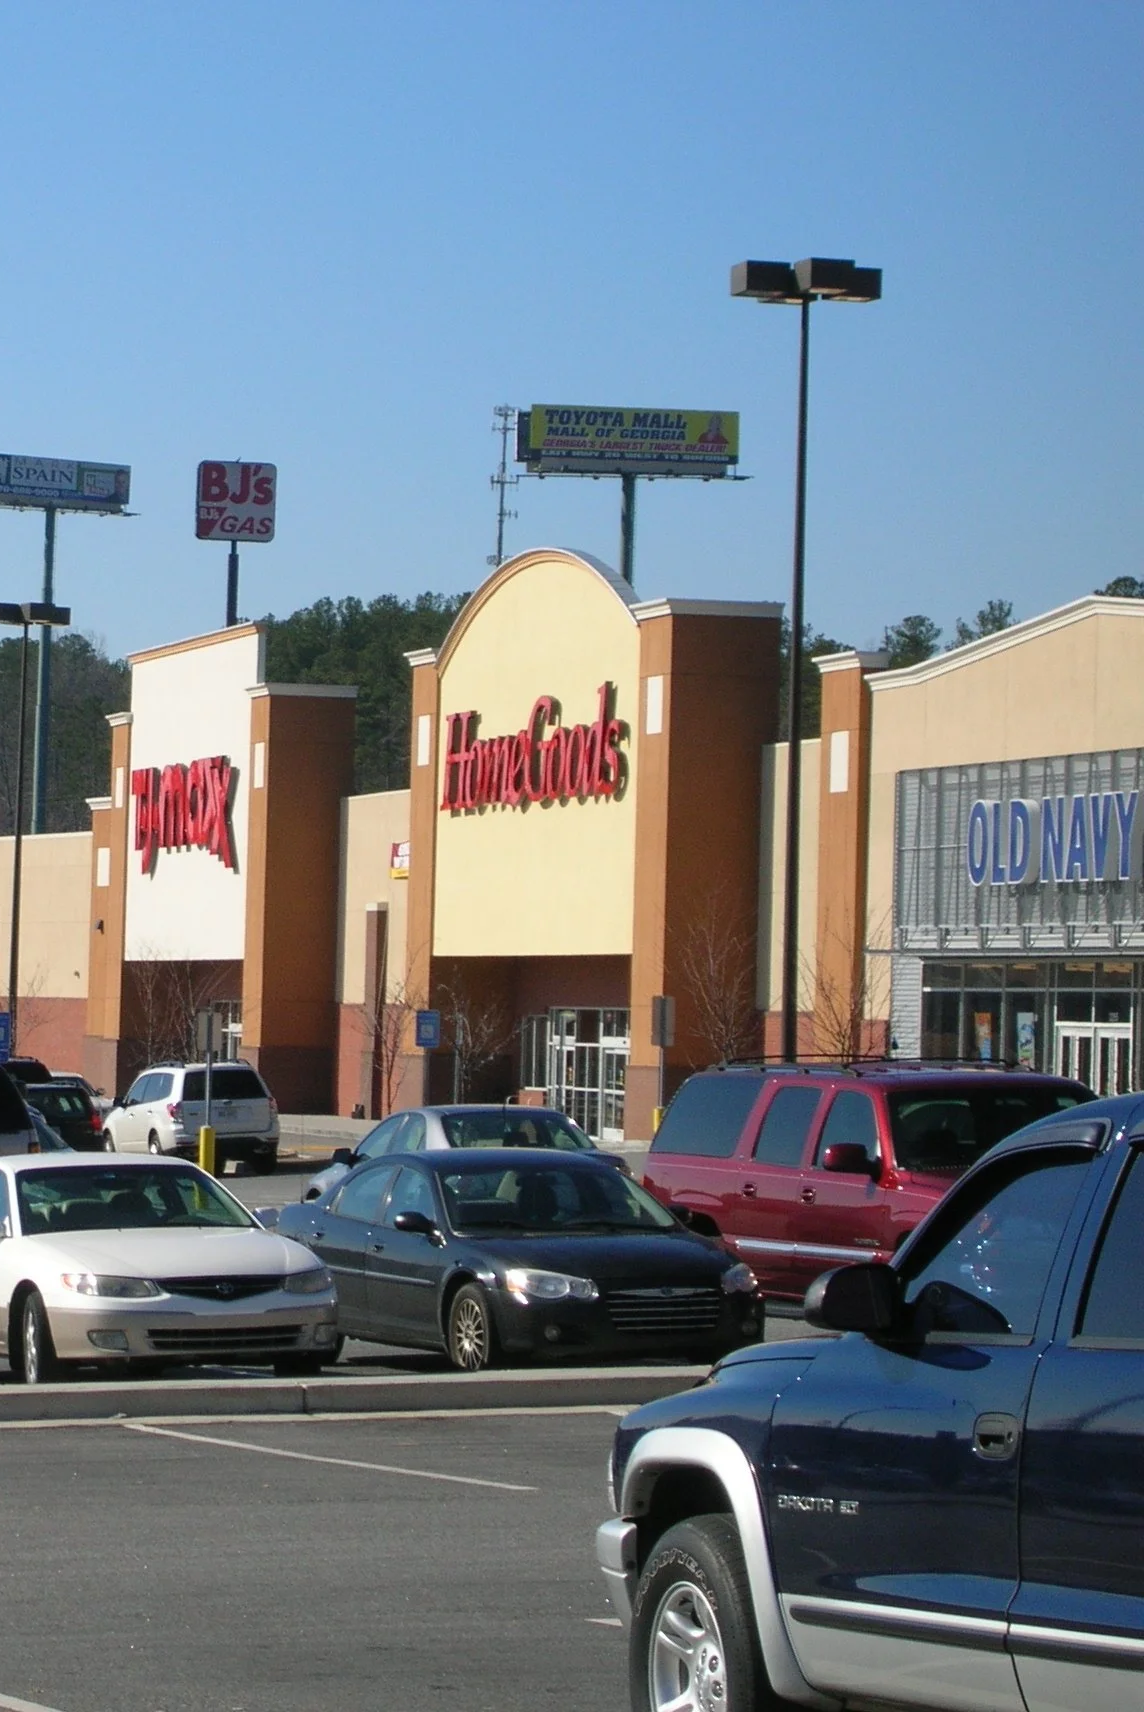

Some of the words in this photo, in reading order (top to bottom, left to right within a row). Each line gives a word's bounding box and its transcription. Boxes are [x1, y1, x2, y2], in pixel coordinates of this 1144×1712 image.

[544, 409, 625, 427] TOYOTA
[632, 412, 688, 430] MALL
[547, 426, 589, 437] MALL
[595, 428, 615, 437] OF
[620, 429, 686, 441] GEORGIA
[12, 466, 74, 484] SPAIN
[202, 464, 273, 505] BJ's
[220, 515, 273, 535] GAS
[440, 681, 621, 811] HomeGoods
[967, 799, 1031, 886] OLD
[1040, 789, 1139, 883] NAVY
